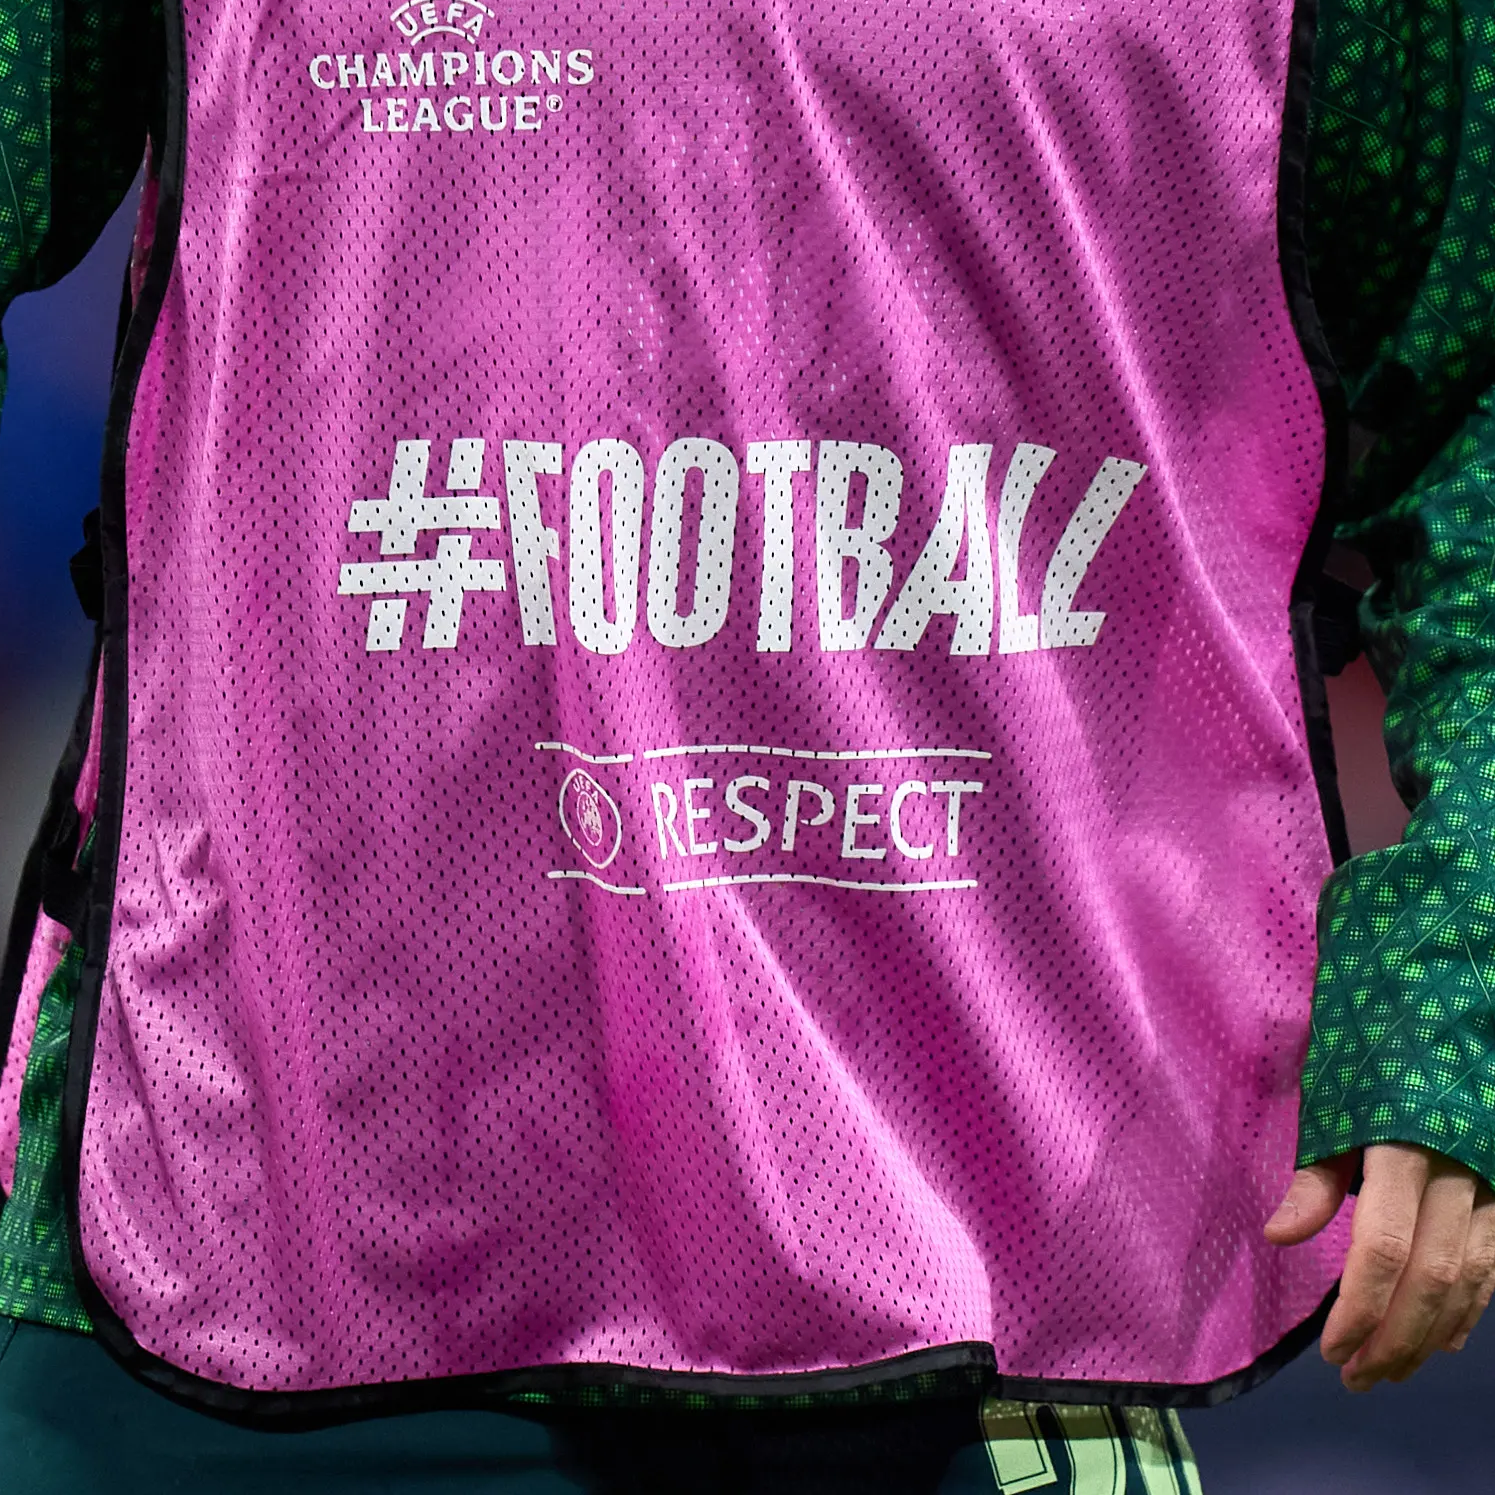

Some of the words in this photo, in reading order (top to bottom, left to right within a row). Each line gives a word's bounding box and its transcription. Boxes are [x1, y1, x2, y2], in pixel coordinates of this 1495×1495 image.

[395, 2, 484, 37] UEFA
[309, 49, 595, 89] CHAMPIONS
[337, 437, 1149, 656] #FOOTBALL
[573, 775, 599, 804] UEFA
[651, 775, 984, 860] RESPECT
